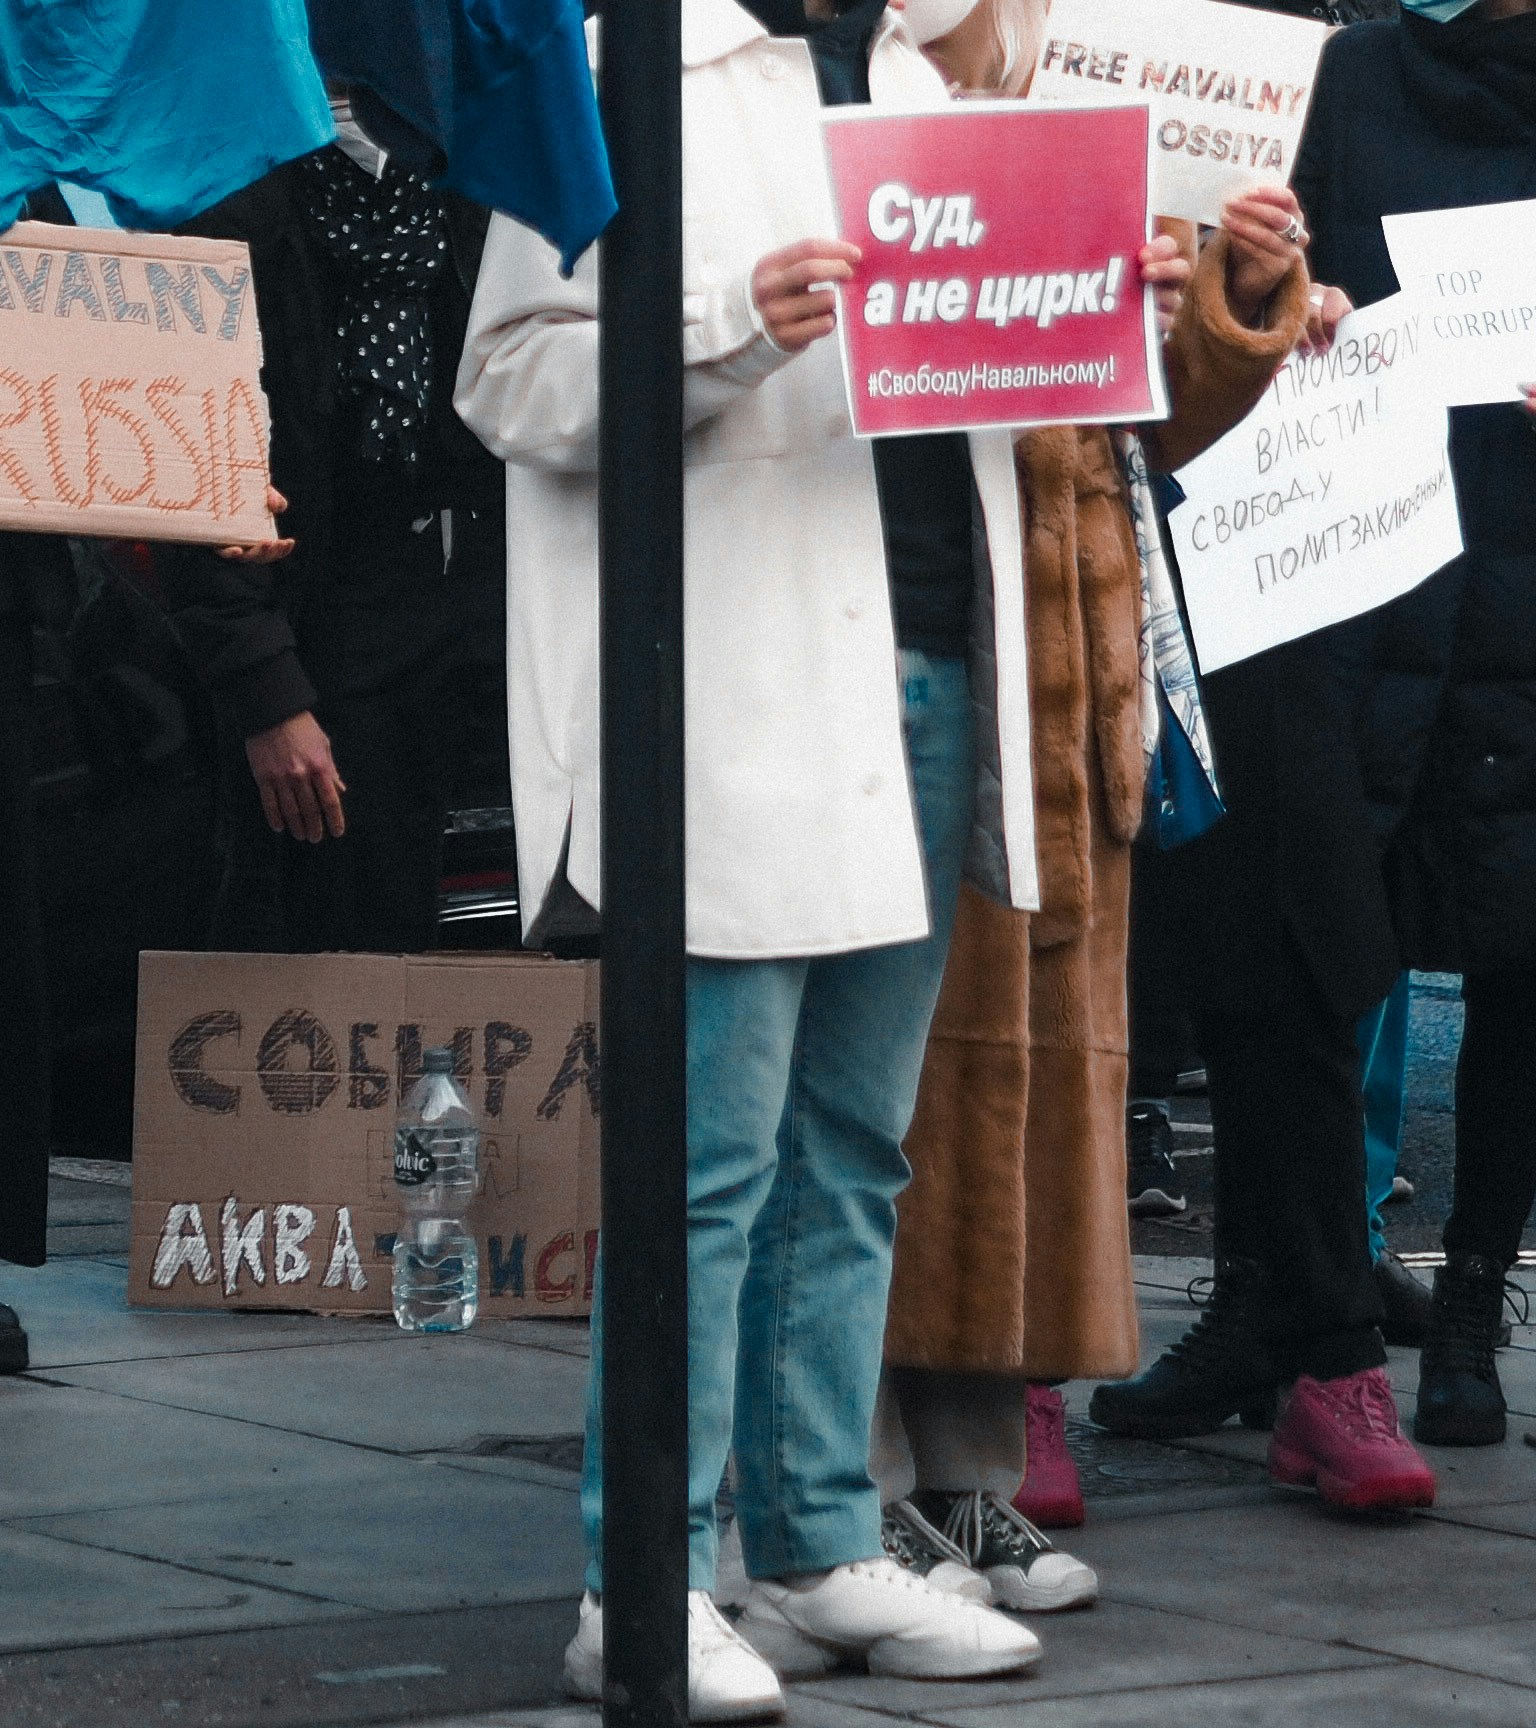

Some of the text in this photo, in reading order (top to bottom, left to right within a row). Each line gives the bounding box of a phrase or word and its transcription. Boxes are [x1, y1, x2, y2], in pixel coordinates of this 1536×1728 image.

[1041, 38, 1306, 117] FREE NAVALNY
[1156, 118, 1284, 172] OSSIYA
[866, 184, 985, 253] Суд,
[864, 256, 1124, 329] а не цирк!
[867, 354, 1117, 398] #СвободуНавальному!
[1191, 470, 1332, 553] СВОБОДУ
